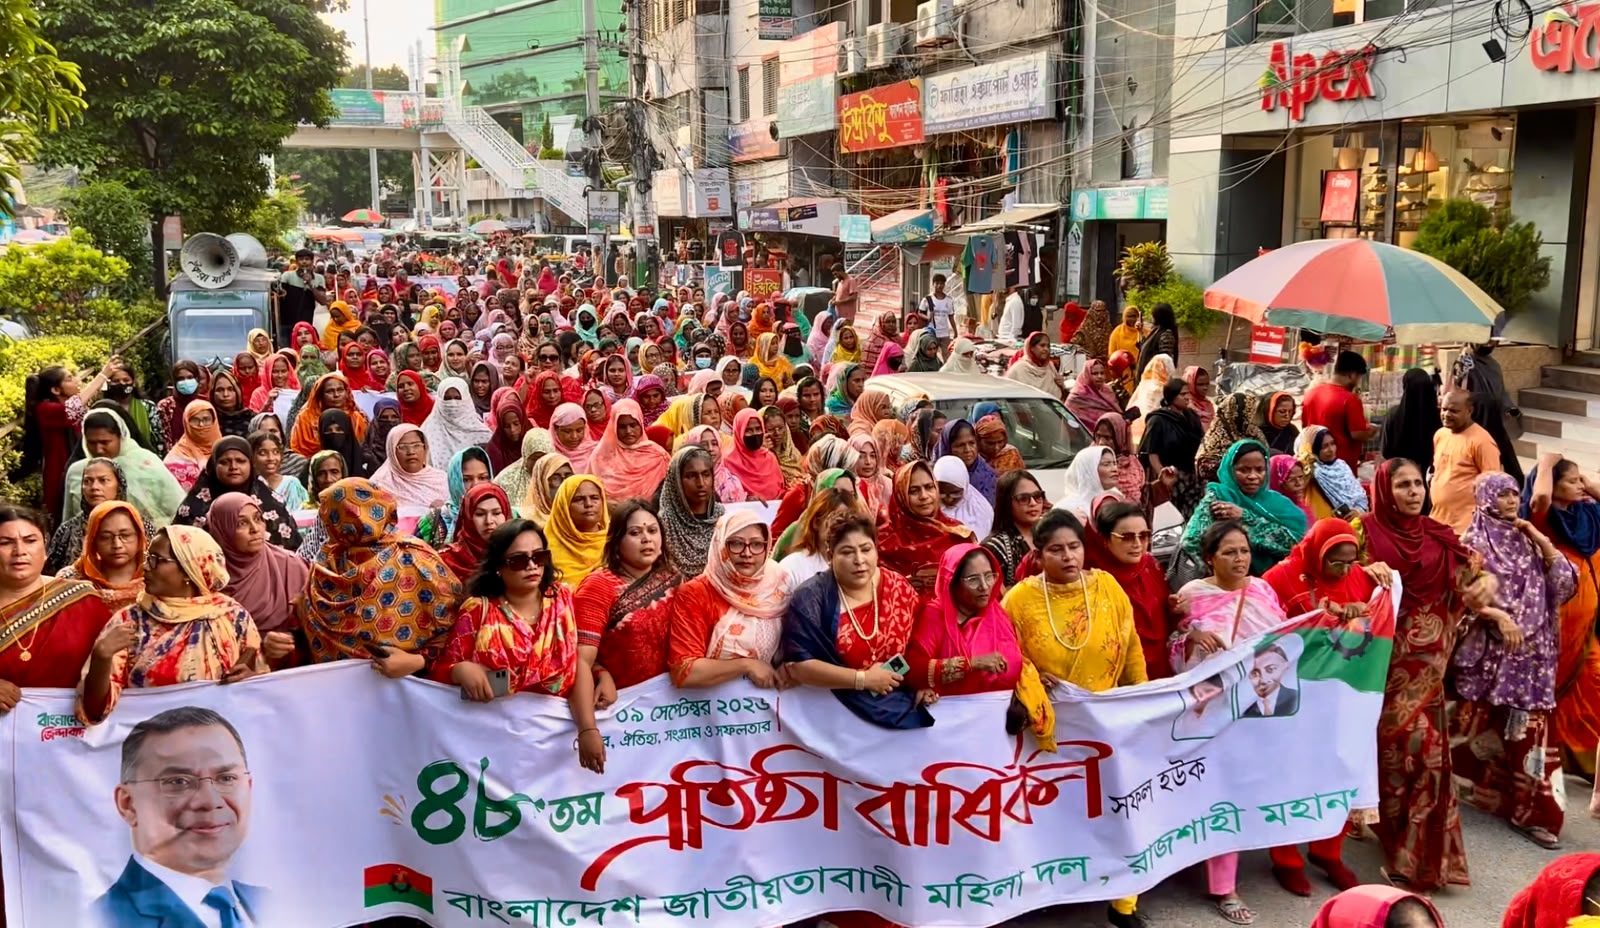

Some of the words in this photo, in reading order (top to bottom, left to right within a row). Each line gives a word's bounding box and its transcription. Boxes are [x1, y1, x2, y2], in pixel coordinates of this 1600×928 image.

[1261, 41, 1376, 121] Apex
[37, 712, 80, 727] বাংলাদে
[616, 708, 644, 723] ০৯
[650, 697, 711, 722] সেপ্টেম্বর
[717, 696, 770, 716] ২০২৬
[664, 726, 701, 742] সংগ্রাম
[704, 726, 713, 738] ও
[715, 720, 772, 737] সফলতার
[580, 744, 839, 892] প্রতিষ্ঠা
[854, 734, 1113, 847] বার্ষিকী
[1108, 779, 1152, 819] সফল
[1157, 757, 1206, 791] হউক
[443, 890, 646, 928] বাংলাদেশ
[660, 865, 912, 919] জাতীয়তাবাদী
[923, 871, 1025, 908] মহিলা
[1032, 856, 1091, 886] দল
[1125, 801, 1246, 875] রাজশাহী
[1257, 788, 1359, 826] মহান
